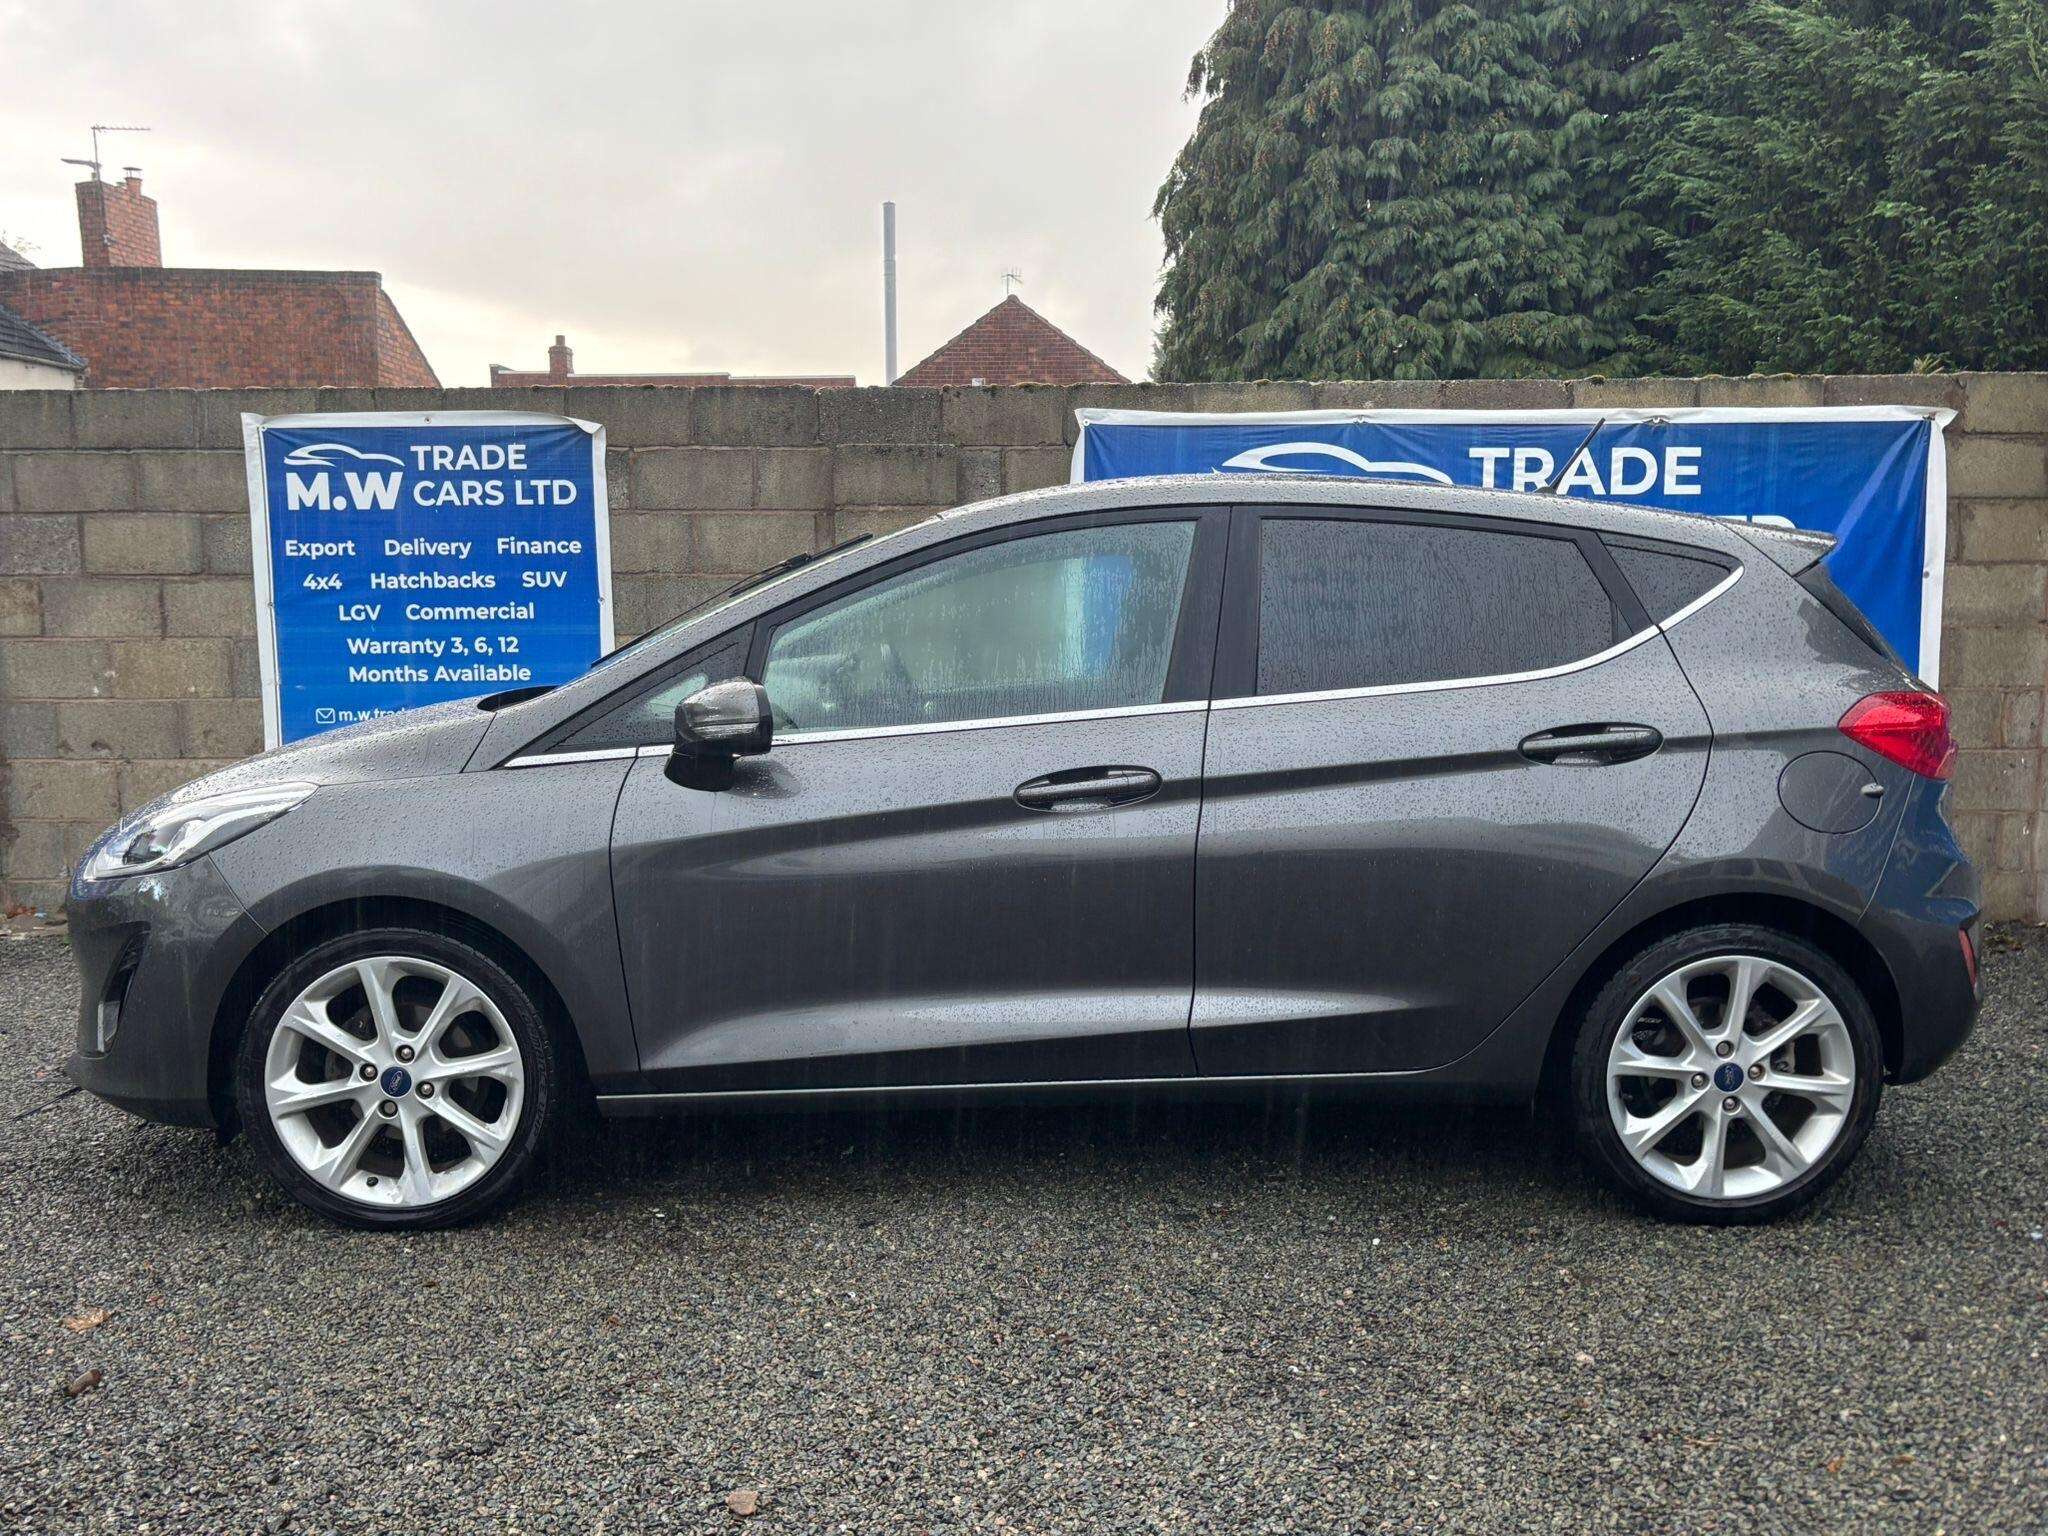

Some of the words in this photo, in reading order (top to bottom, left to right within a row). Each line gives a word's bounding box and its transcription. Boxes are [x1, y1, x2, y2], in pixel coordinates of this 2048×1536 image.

[411, 443, 527, 470] TRADE
[1469, 447, 1701, 495] TRADE
[286, 472, 403, 510] M.W
[414, 480, 504, 506] CARS
[516, 480, 576, 504] LTD
[286, 540, 355, 559] Export
[385, 538, 471, 559] Delivery
[498, 537, 581, 553] Finance
[304, 574, 342, 589] 4x4
[371, 572, 495, 588] Hatchbacks
[523, 572, 566, 587] SUV
[340, 605, 380, 620] LGV
[406, 602, 534, 619] Commercial
[348, 639, 445, 656] Warranty
[452, 638, 468, 655] 3,
[475, 637, 492, 655] 6,
[498, 637, 518, 652] 12
[350, 666, 428, 681] Months
[434, 665, 531, 681] Available
